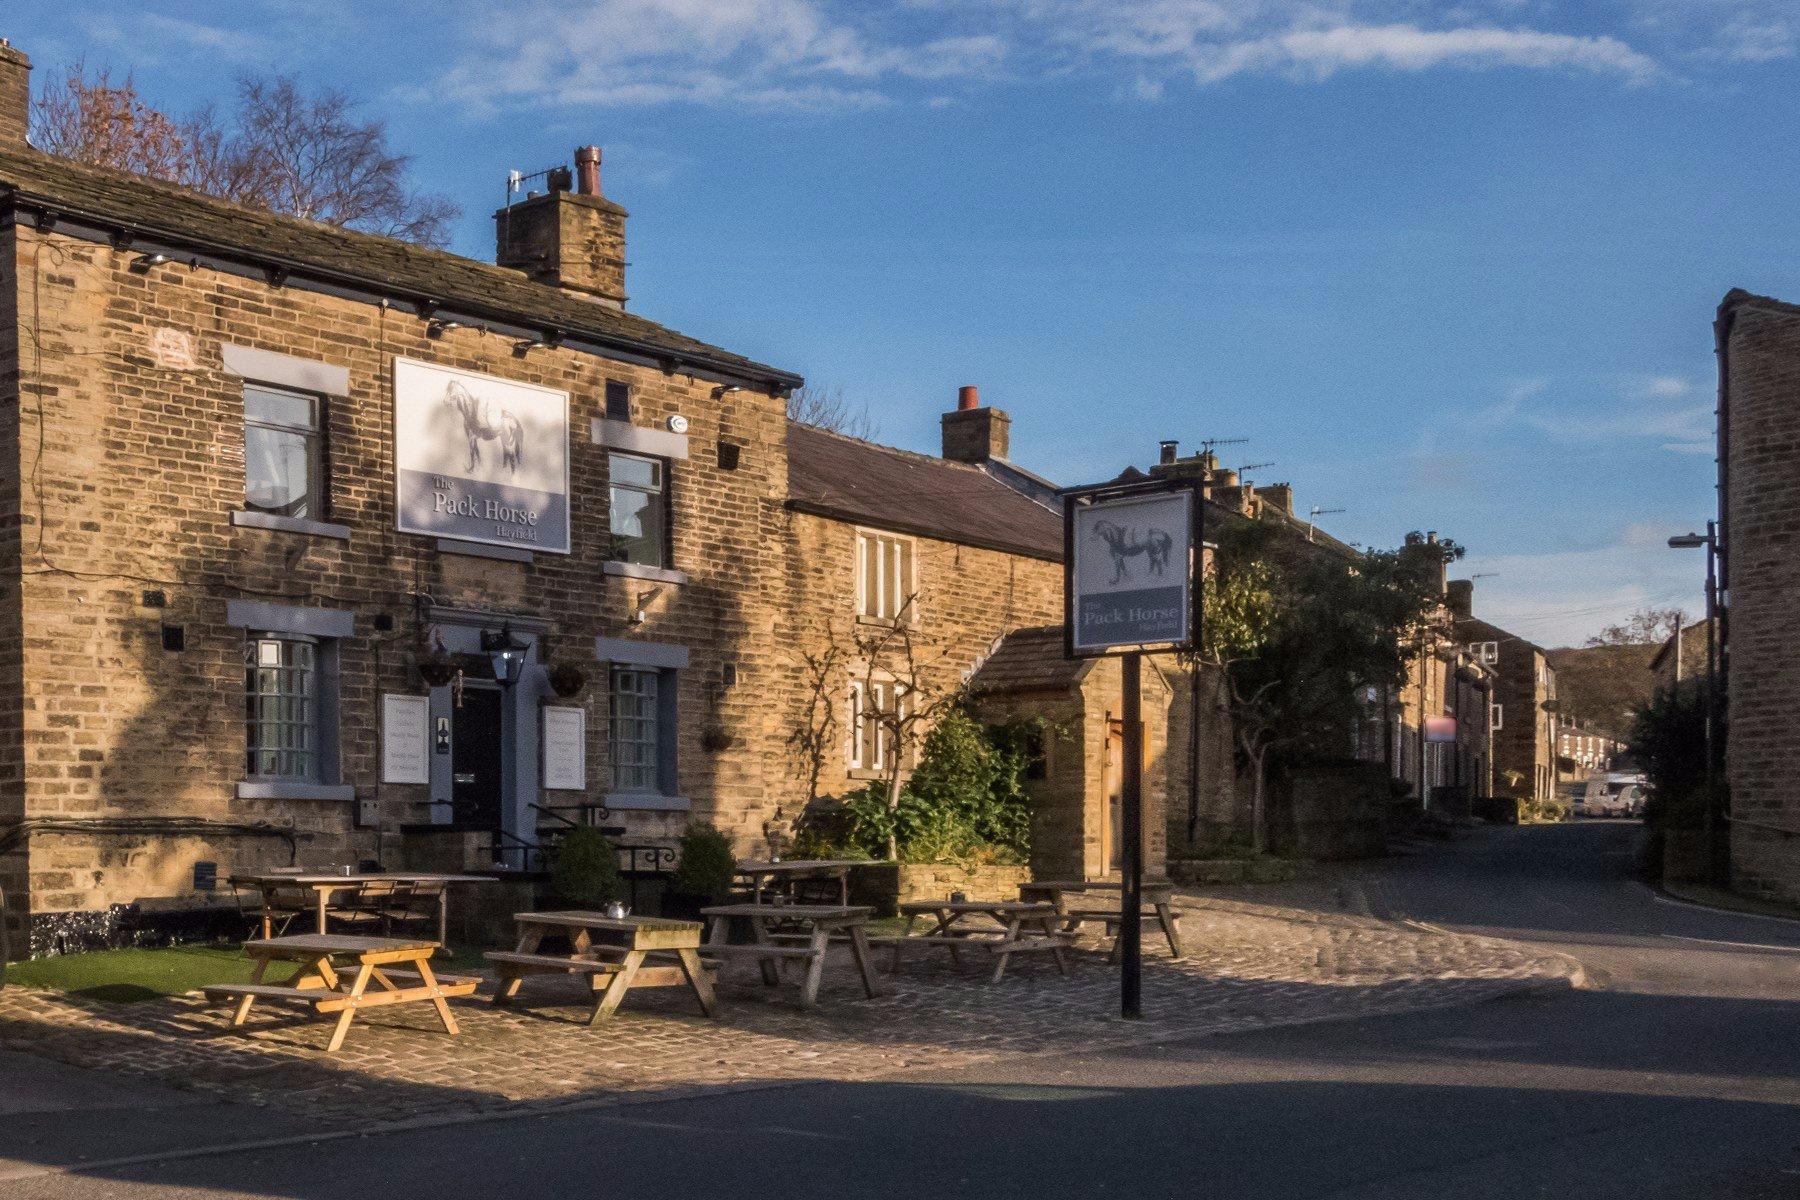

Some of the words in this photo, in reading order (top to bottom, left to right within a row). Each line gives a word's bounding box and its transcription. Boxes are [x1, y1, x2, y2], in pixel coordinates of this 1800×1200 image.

[432, 475, 454, 490] The
[433, 491, 480, 518] Pack
[484, 500, 538, 526] Horse
[497, 525, 537, 541] Hayfield
[1085, 608, 1124, 624] Pack
[1129, 607, 1177, 622] Horse
